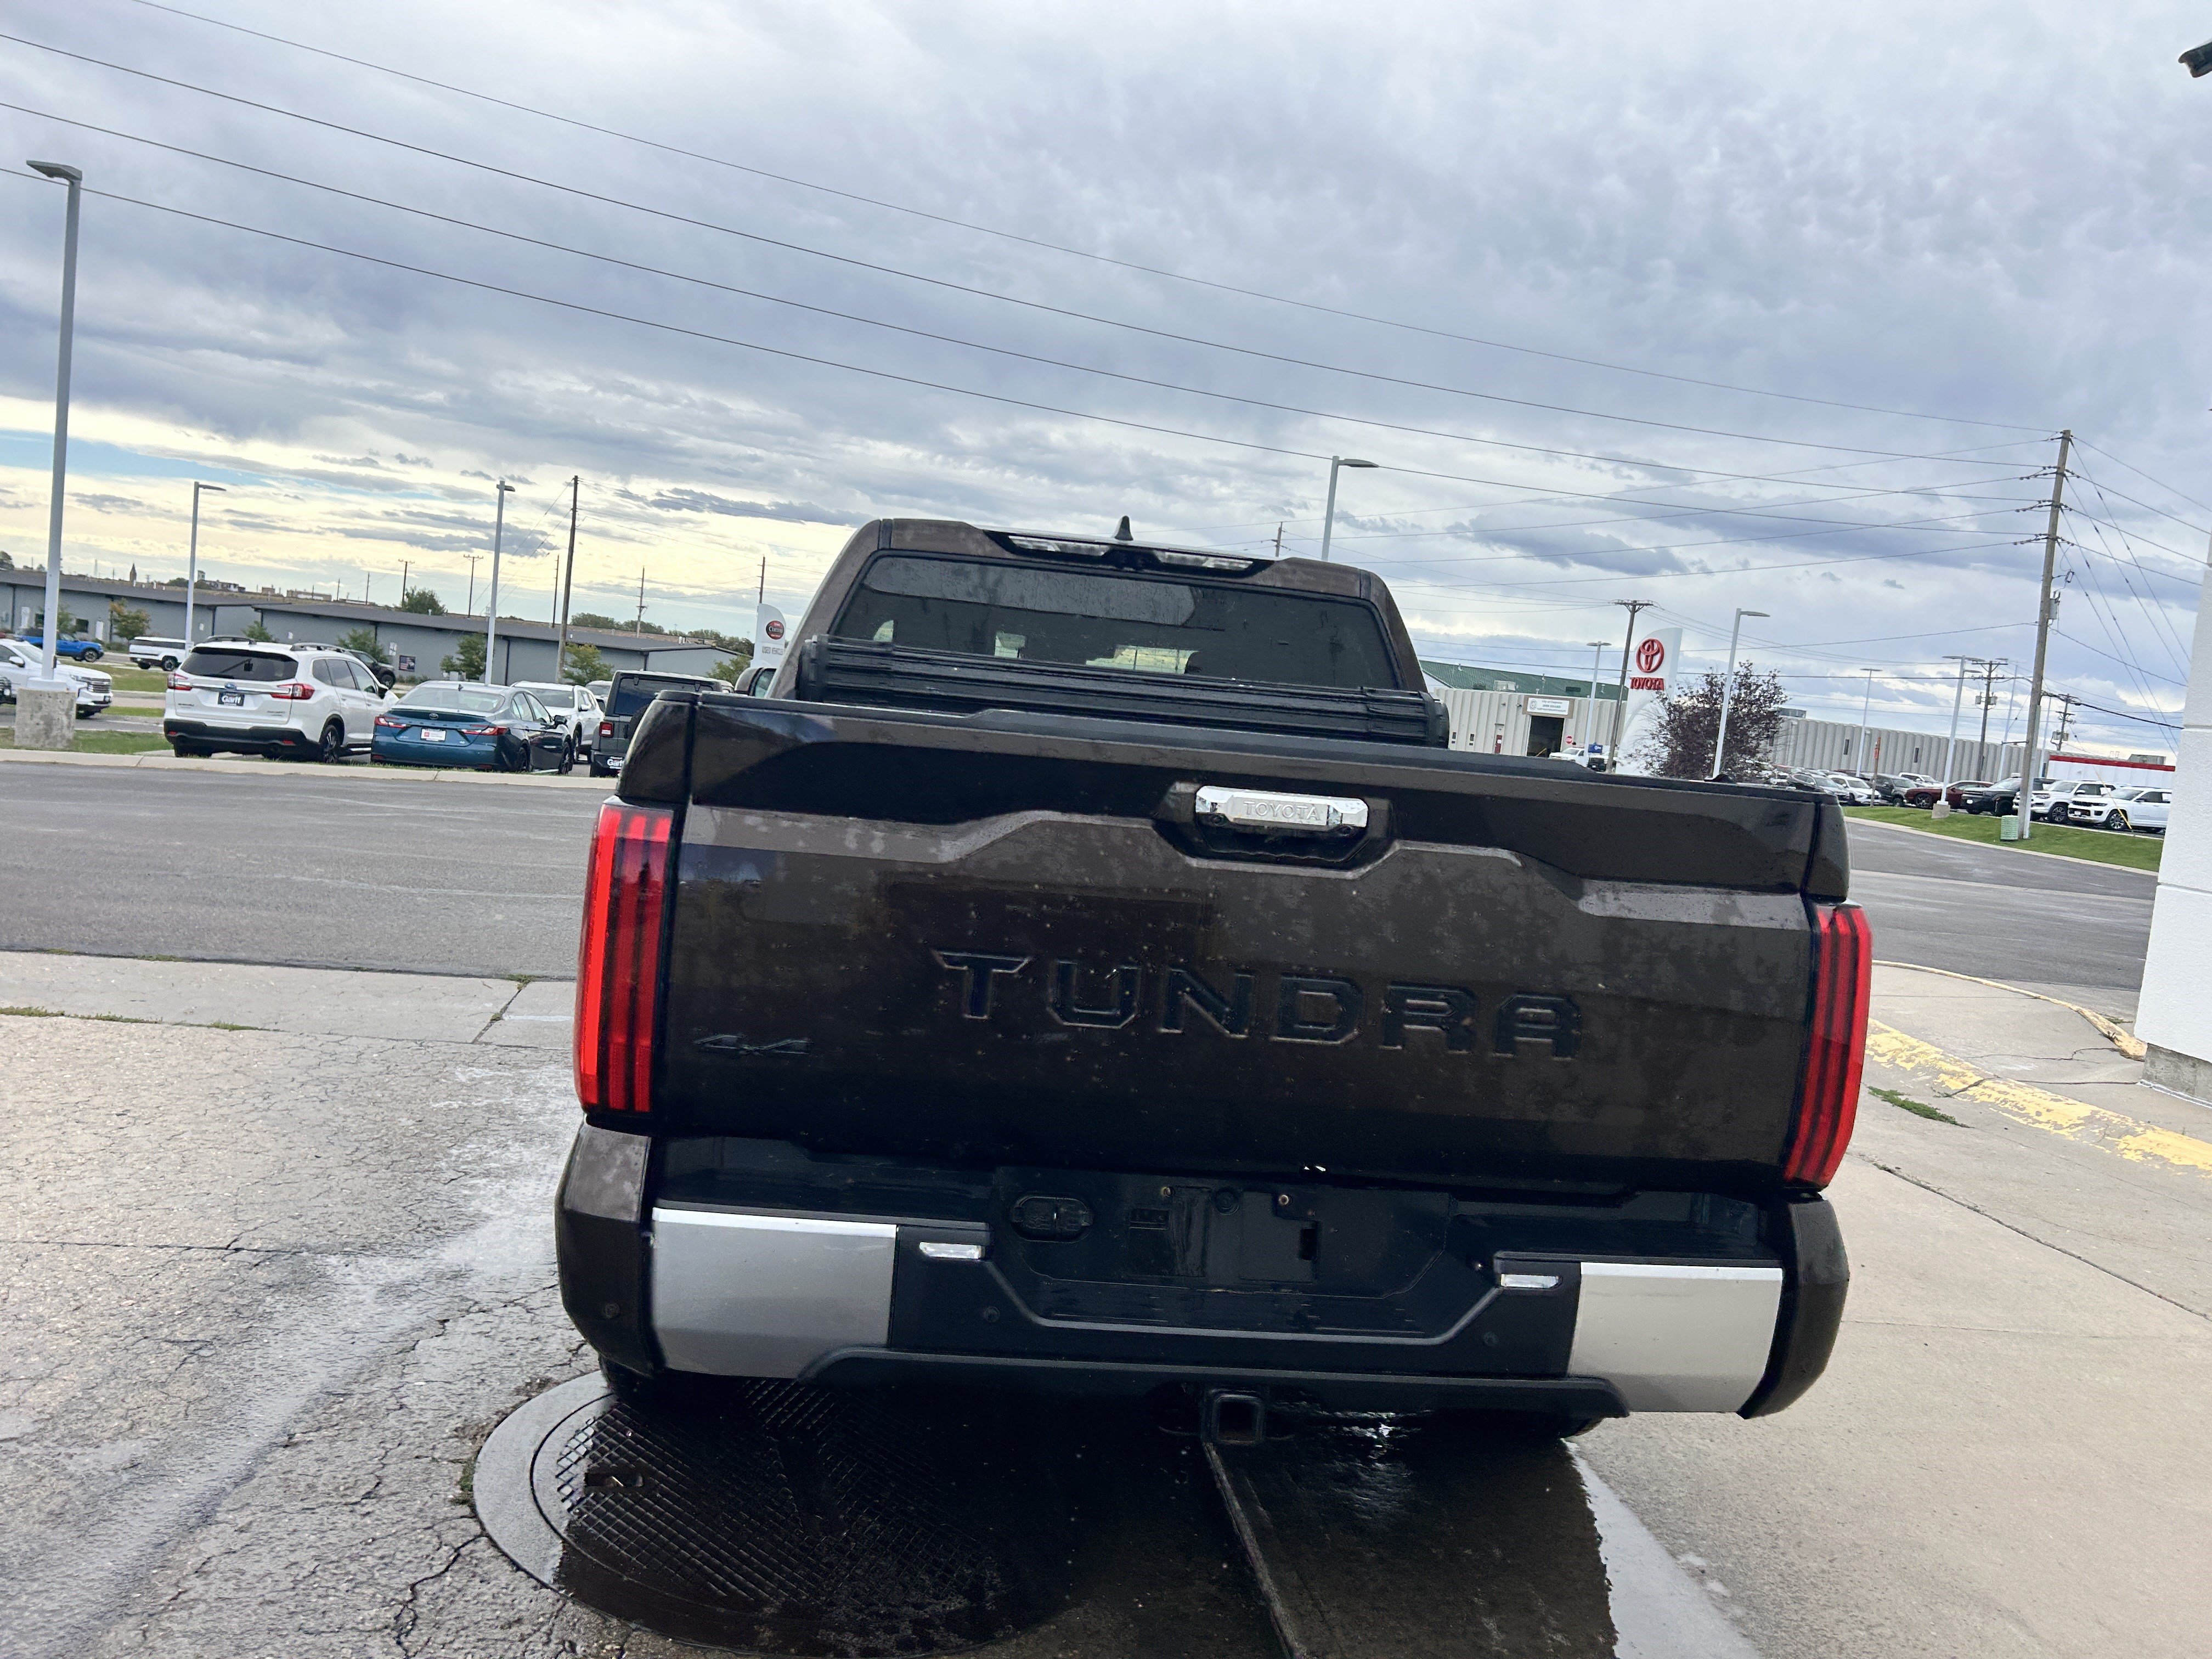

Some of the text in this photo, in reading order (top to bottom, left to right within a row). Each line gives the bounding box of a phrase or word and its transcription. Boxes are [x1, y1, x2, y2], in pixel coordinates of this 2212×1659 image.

[1630, 678, 1664, 691] TOYOTA
[1243, 801, 1320, 821] TOYOTA
[932, 950, 1579, 1060] TUNDRA
